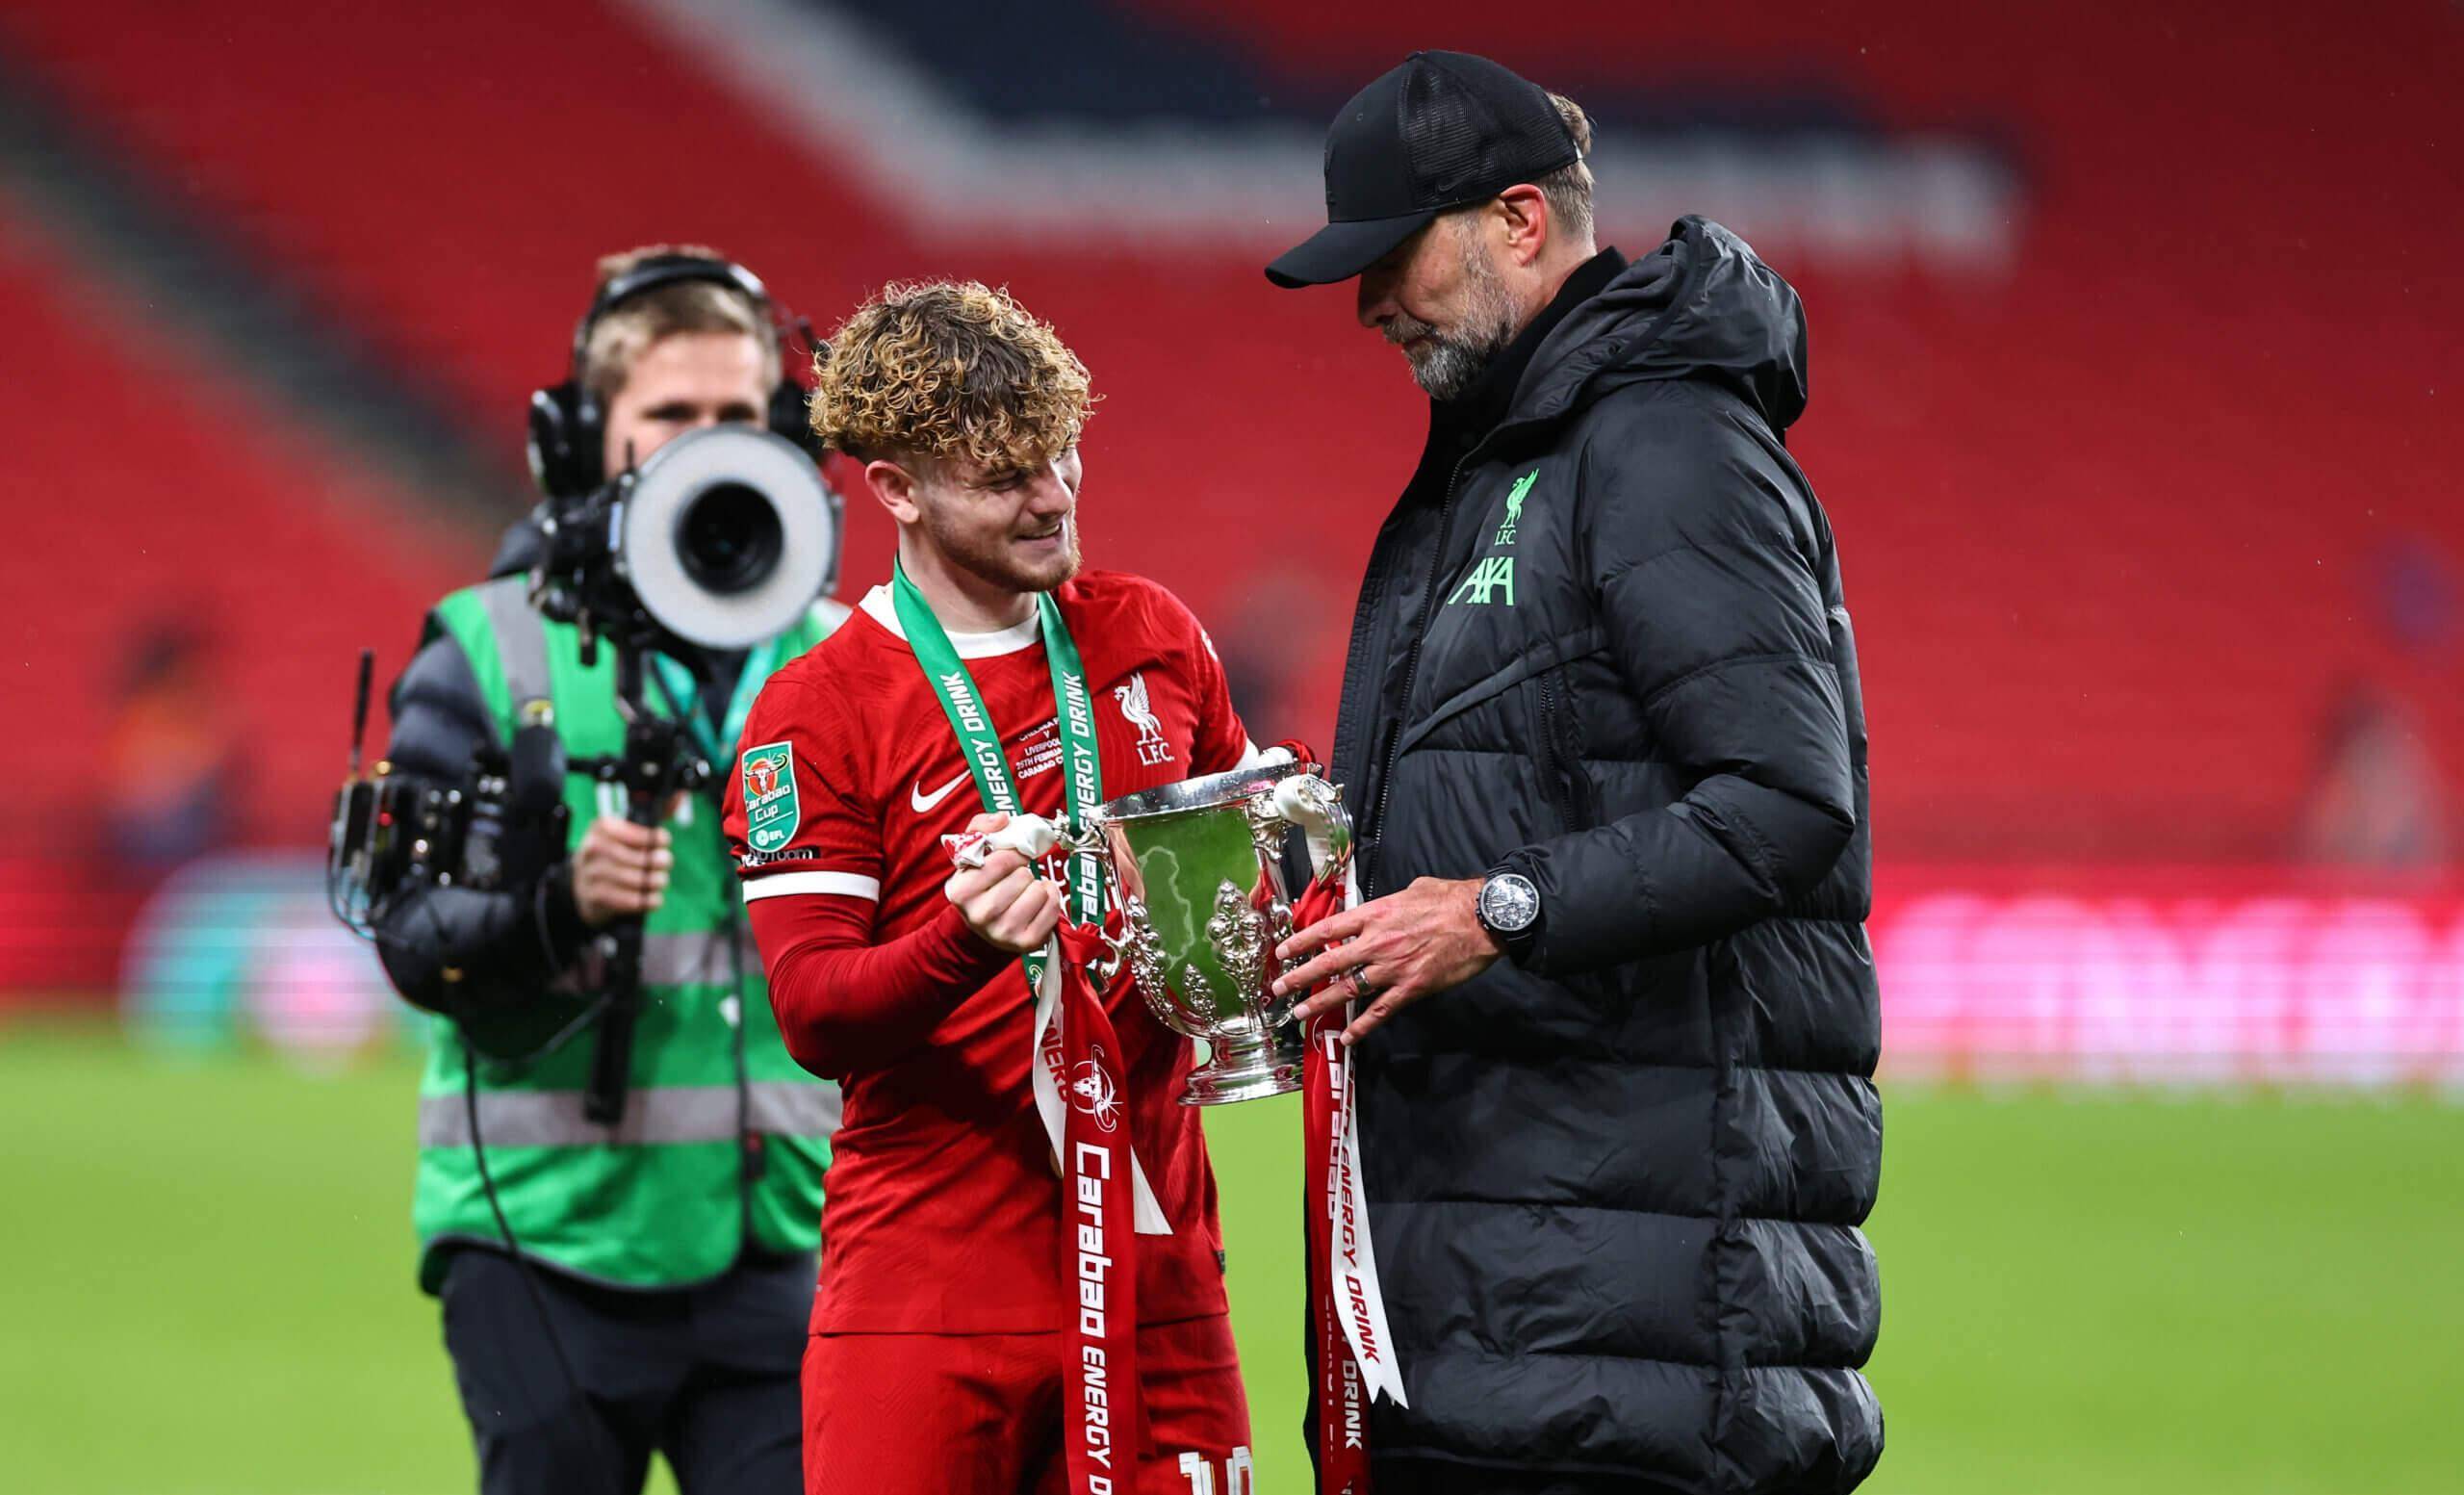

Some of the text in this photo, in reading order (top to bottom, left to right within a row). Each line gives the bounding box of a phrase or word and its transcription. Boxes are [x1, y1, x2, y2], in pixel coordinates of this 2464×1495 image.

[1447, 556, 1515, 606] AXA
[939, 671, 987, 733] DRINK
[1062, 671, 1090, 738] DRINK
[755, 804, 779, 822] Cup
[769, 830, 785, 841] EFL
[1075, 1141, 1113, 1338] Carabao
[1341, 1146, 1357, 1269] ENERGY
[1345, 1275, 1381, 1365] DRINK
[1082, 1344, 1112, 1470] ENERGY
[1342, 1359, 1363, 1451] DRINK
